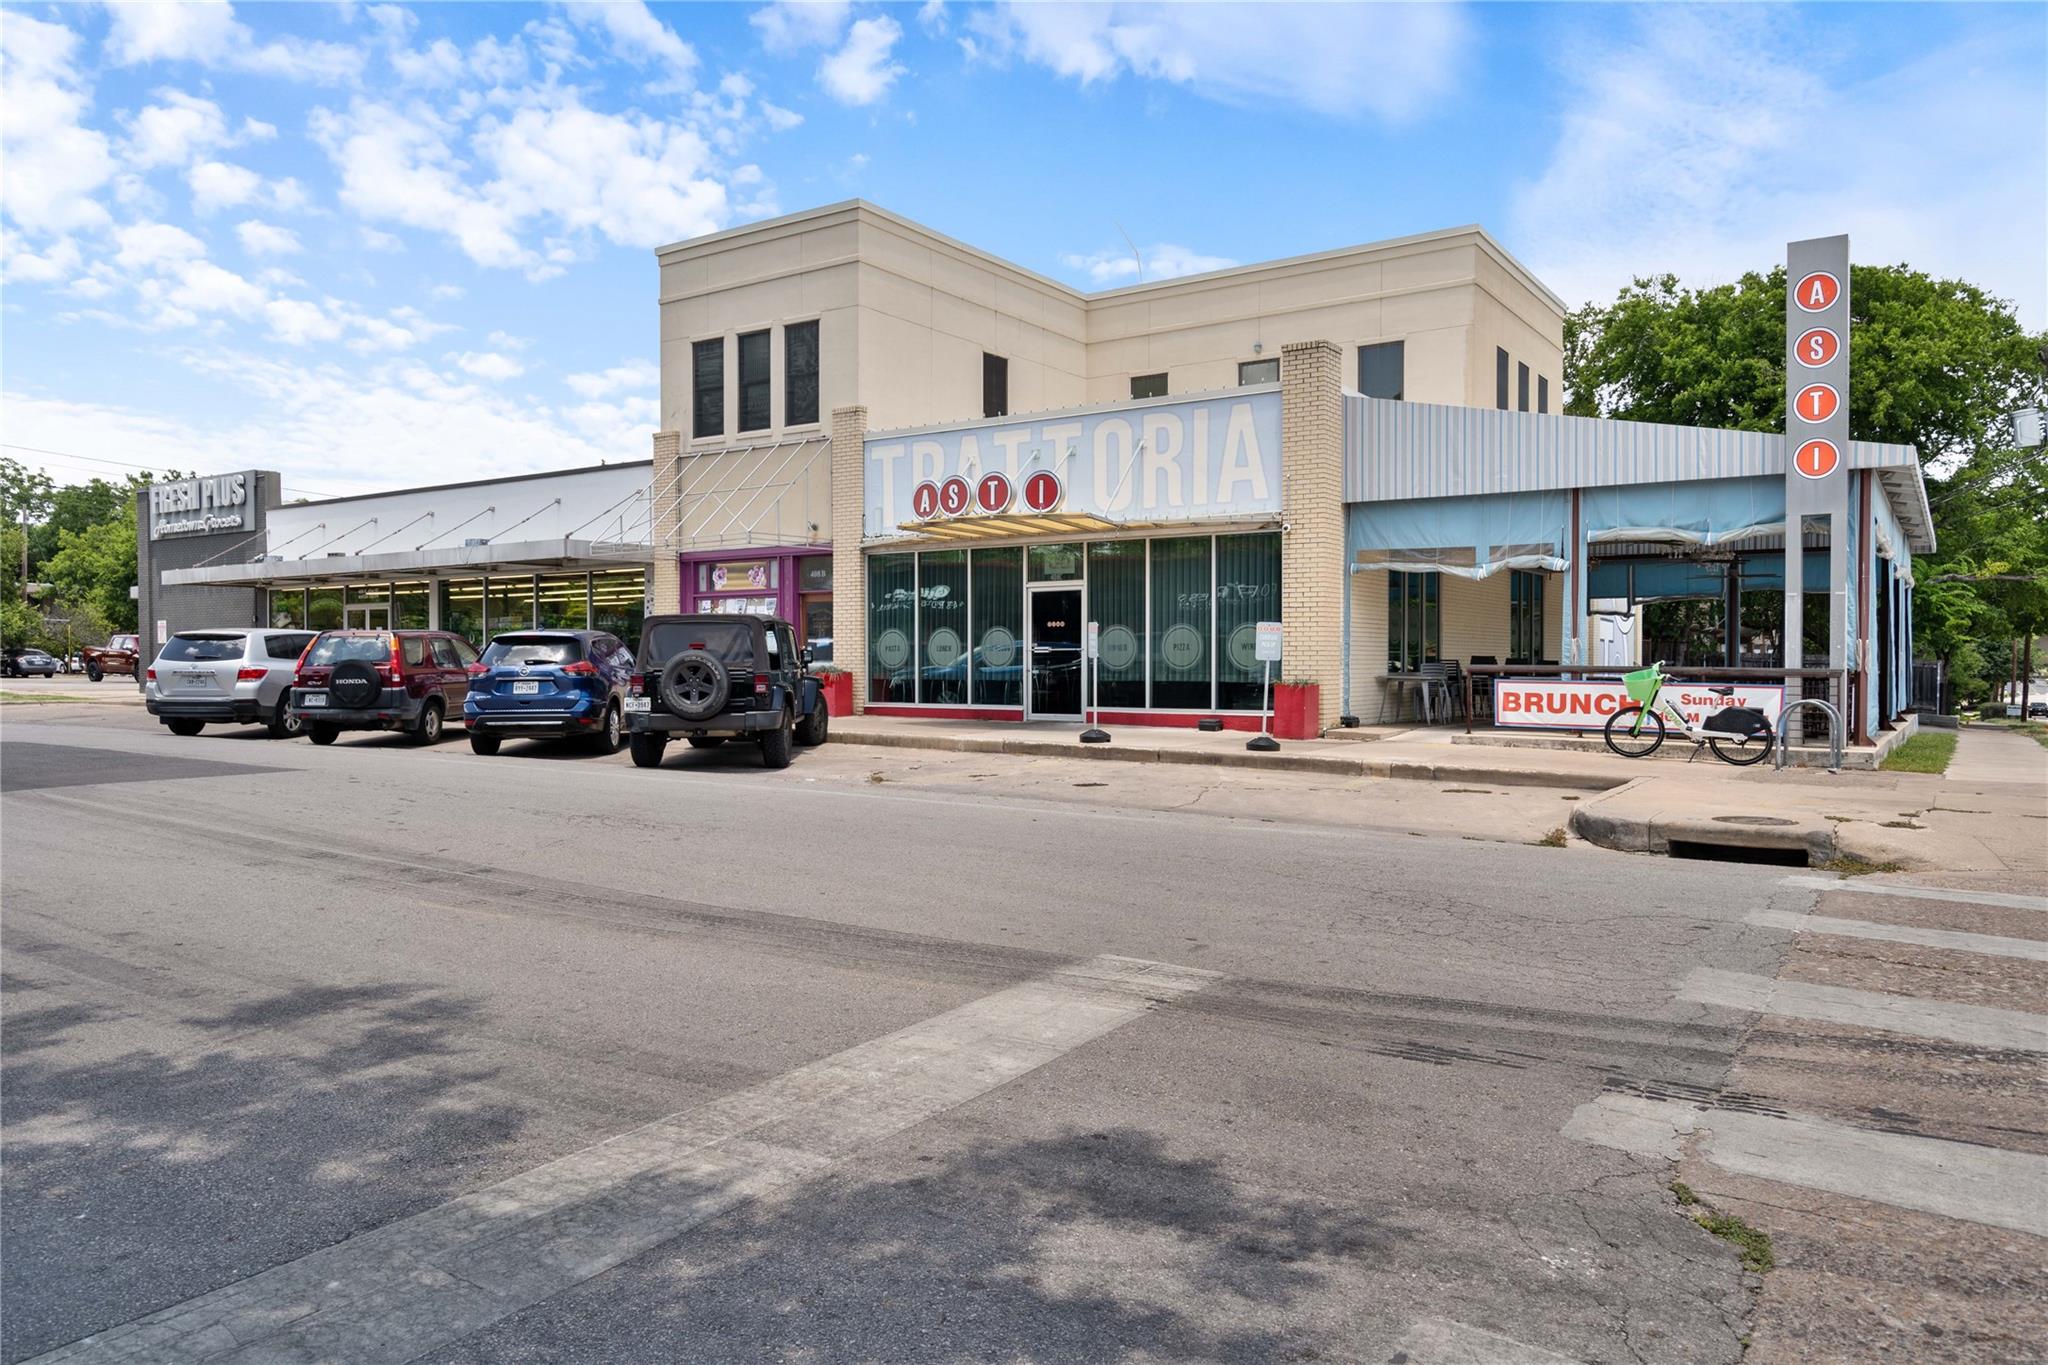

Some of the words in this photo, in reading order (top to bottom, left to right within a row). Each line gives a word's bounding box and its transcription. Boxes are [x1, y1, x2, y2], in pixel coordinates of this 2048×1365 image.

[152, 483, 200, 513] FRESH
[202, 474, 245, 508] PLUS
[917, 476, 1048, 515] ASTI
[1172, 642, 1191, 652] PIZZA
[1680, 693, 1747, 709] Sunday
